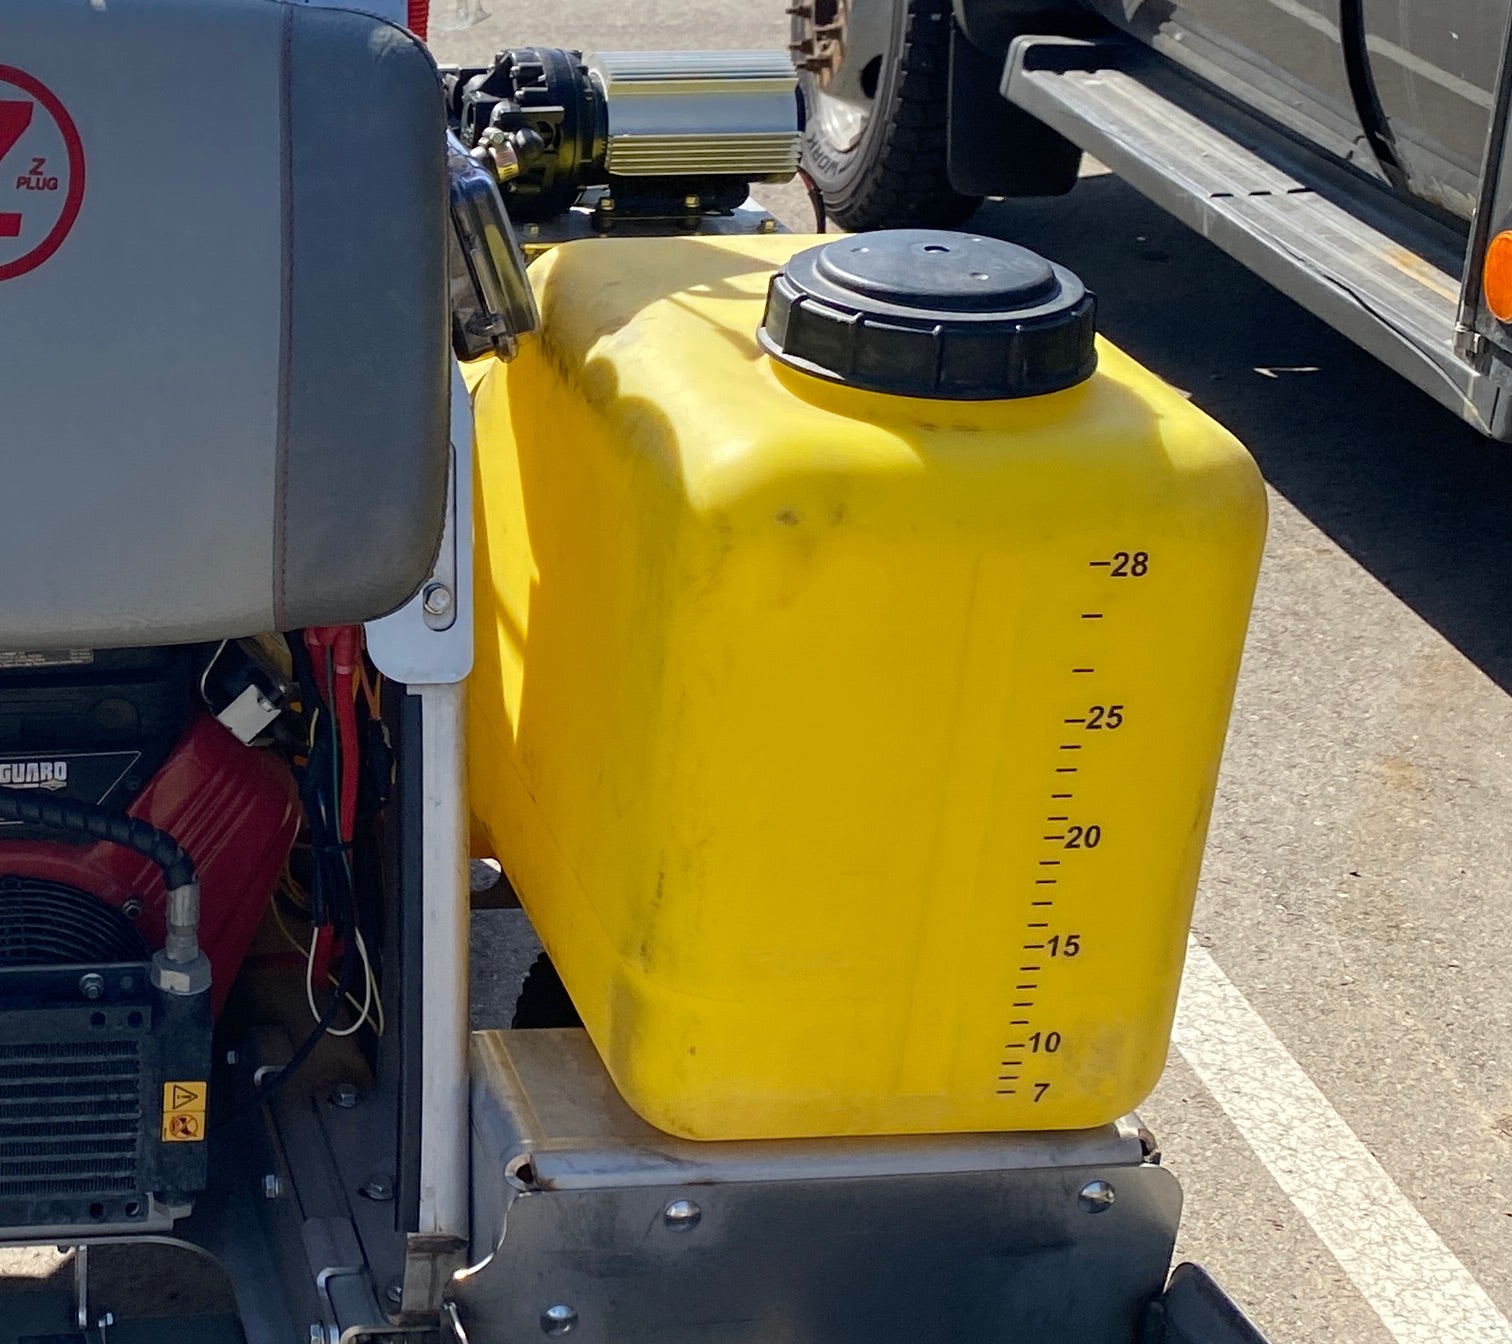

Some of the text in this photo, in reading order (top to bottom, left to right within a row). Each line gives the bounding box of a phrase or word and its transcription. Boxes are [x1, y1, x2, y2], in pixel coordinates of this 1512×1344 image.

[29, 158, 46, 176] Z
[16, 176, 58, 191] PLUG
[1110, 552, 1149, 577] 28
[1086, 705, 1124, 730] 25
[1064, 825, 1101, 849] 20
[1046, 934, 1081, 958] 15
[1028, 1031, 1061, 1054] 10
[1033, 1083, 1051, 1103] 7
